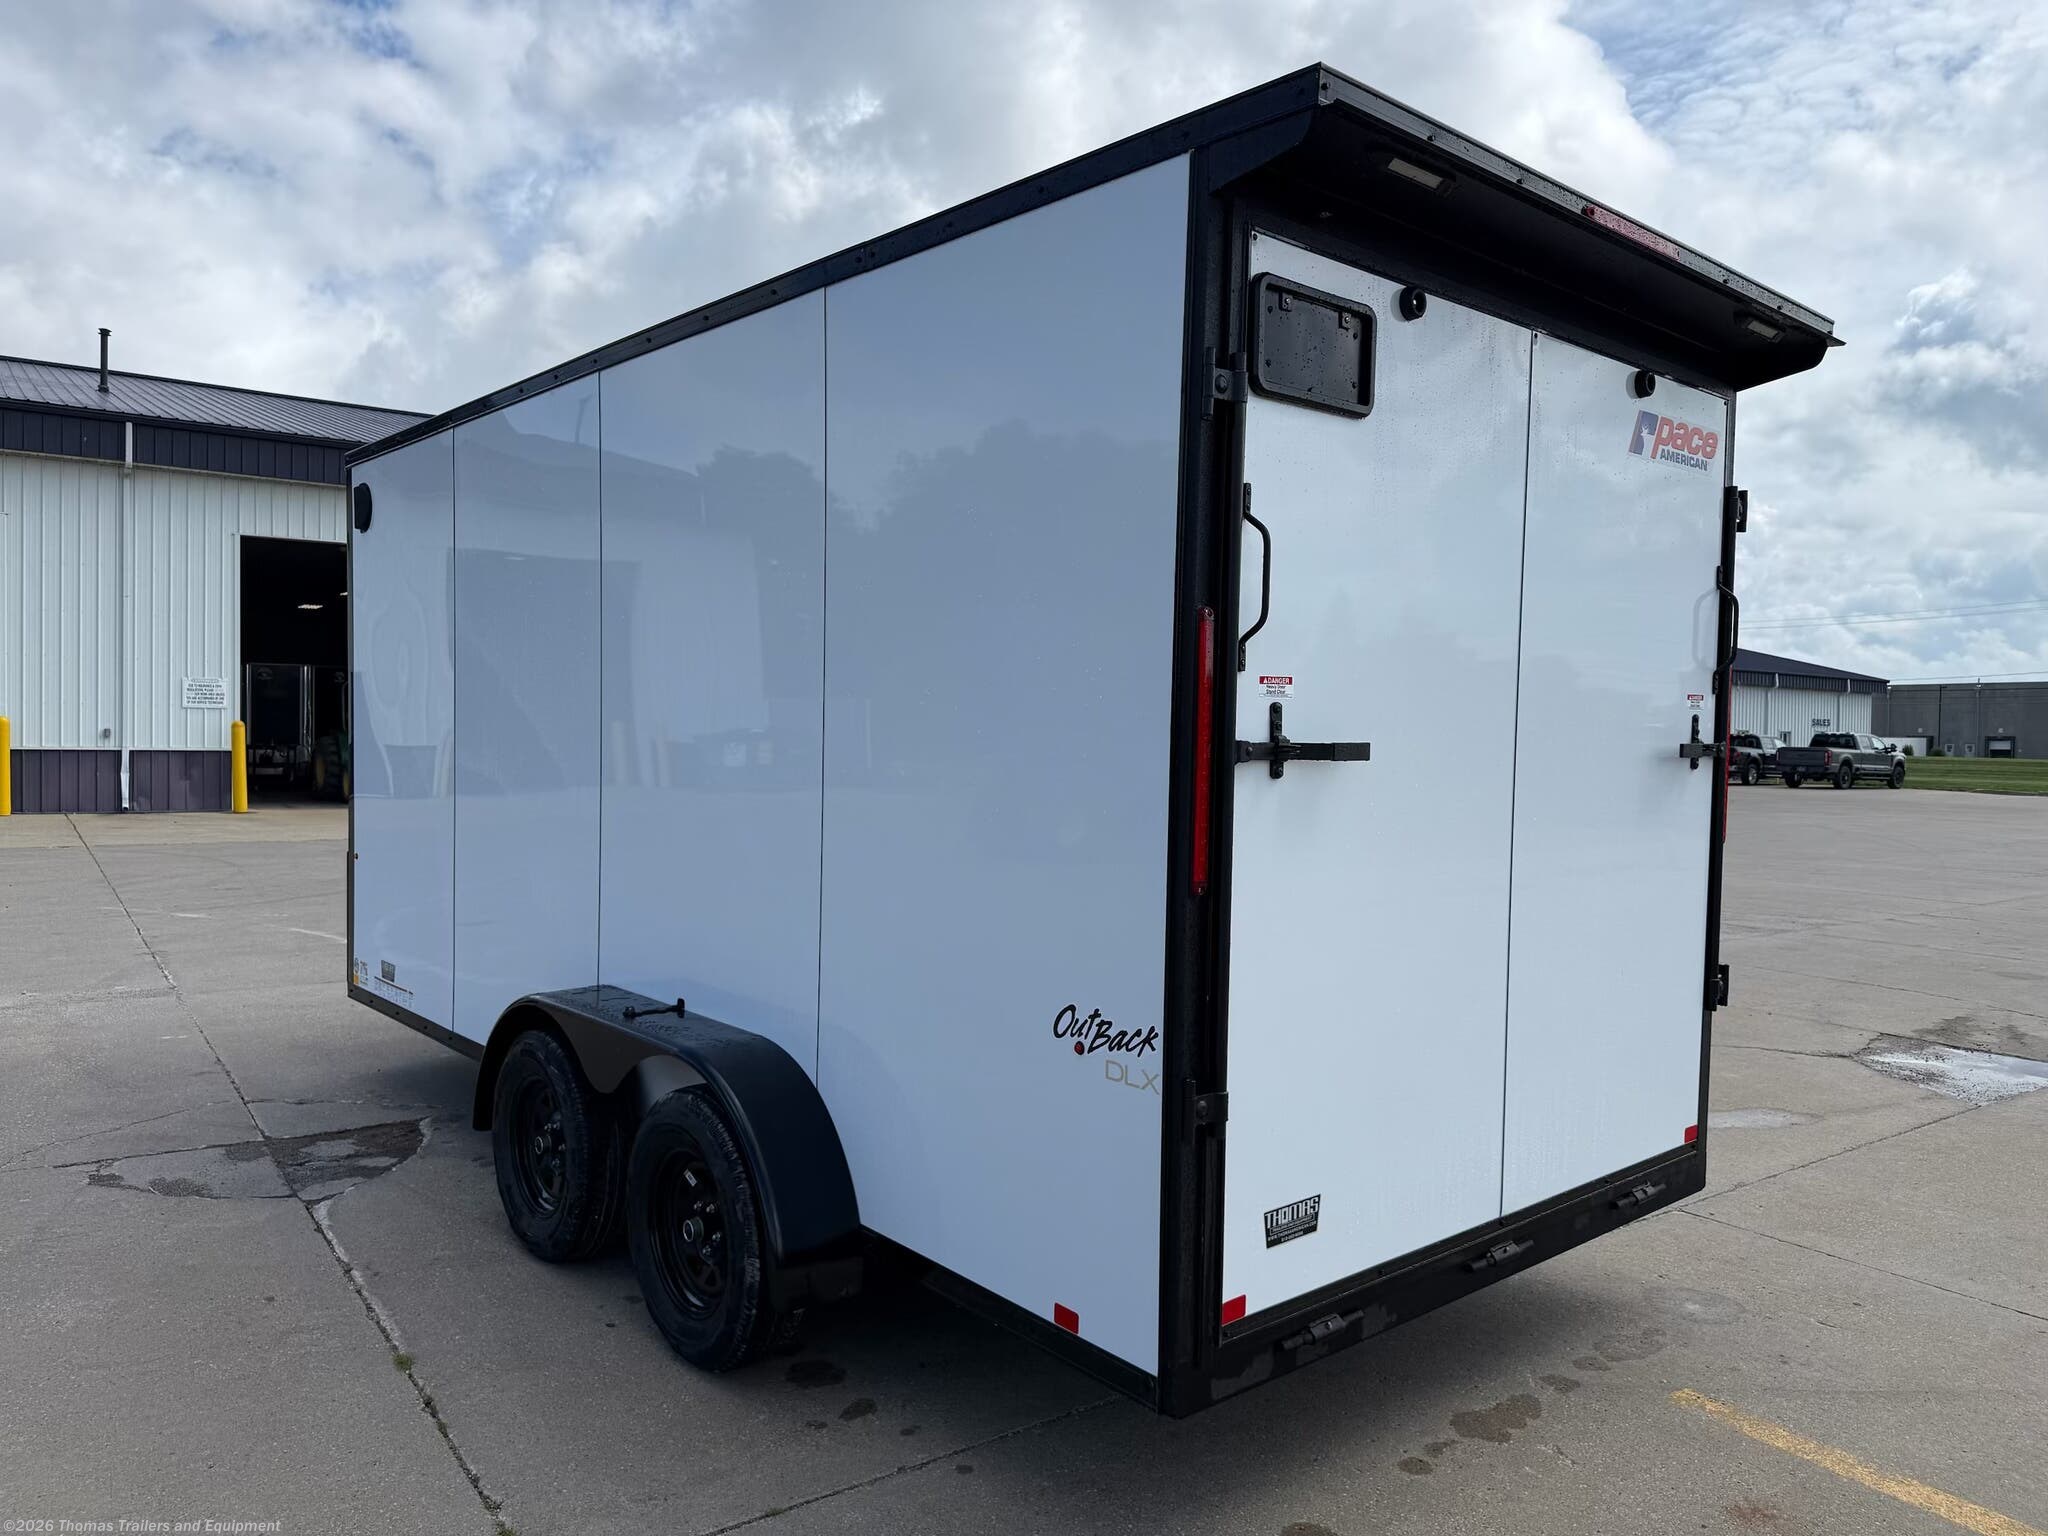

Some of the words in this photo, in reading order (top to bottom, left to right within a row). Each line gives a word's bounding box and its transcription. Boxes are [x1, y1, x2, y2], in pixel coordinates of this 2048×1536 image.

[1650, 416, 1718, 459] pace
[1660, 448, 1708, 471] AMERICAN
[1267, 677, 1290, 685] DANGER
[1811, 718, 1831, 727] SALES
[1106, 1060, 1160, 1095] DLX
[1265, 1197, 1319, 1229] THOMAS
